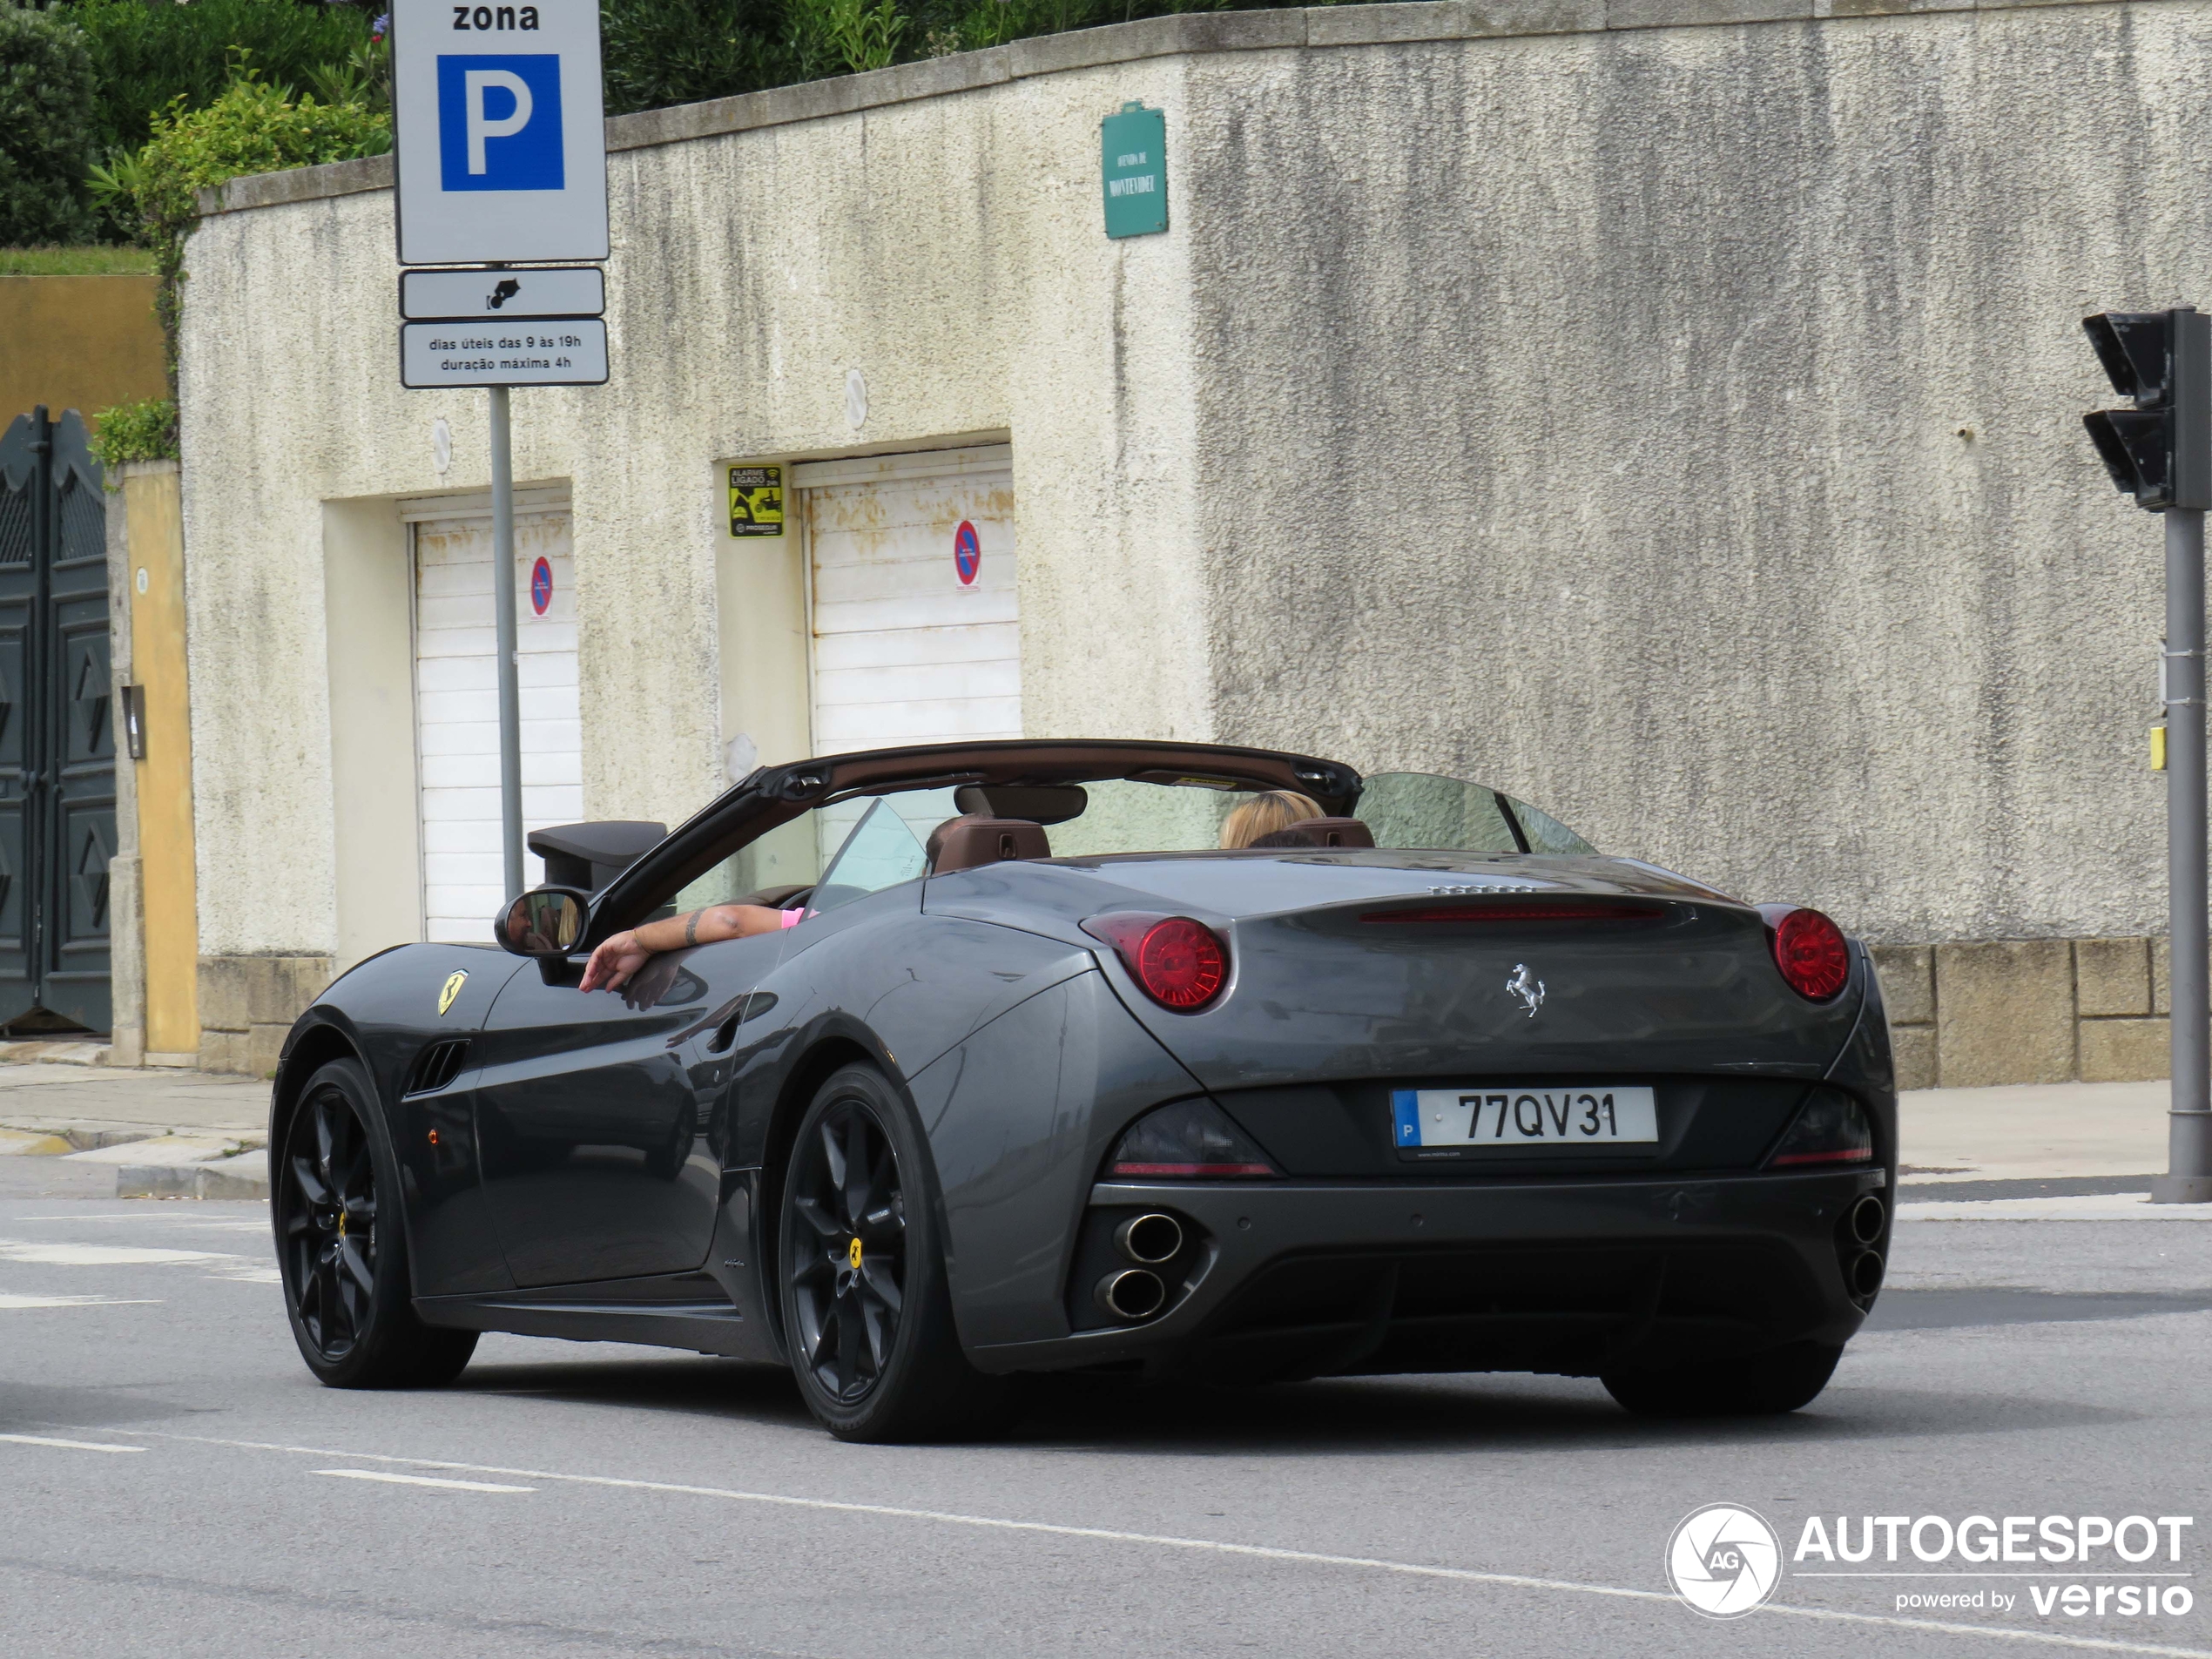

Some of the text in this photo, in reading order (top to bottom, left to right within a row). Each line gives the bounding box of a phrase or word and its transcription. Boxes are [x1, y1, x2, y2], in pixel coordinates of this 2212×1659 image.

[454, 6, 540, 30] zona
[465, 70, 533, 174] P
[429, 335, 582, 350] dias úteis das 9 às 19h
[441, 356, 572, 372] duração máxima 4h
[1459, 1093, 1617, 1139] 77QV31
[1403, 1124, 1413, 1137] P
